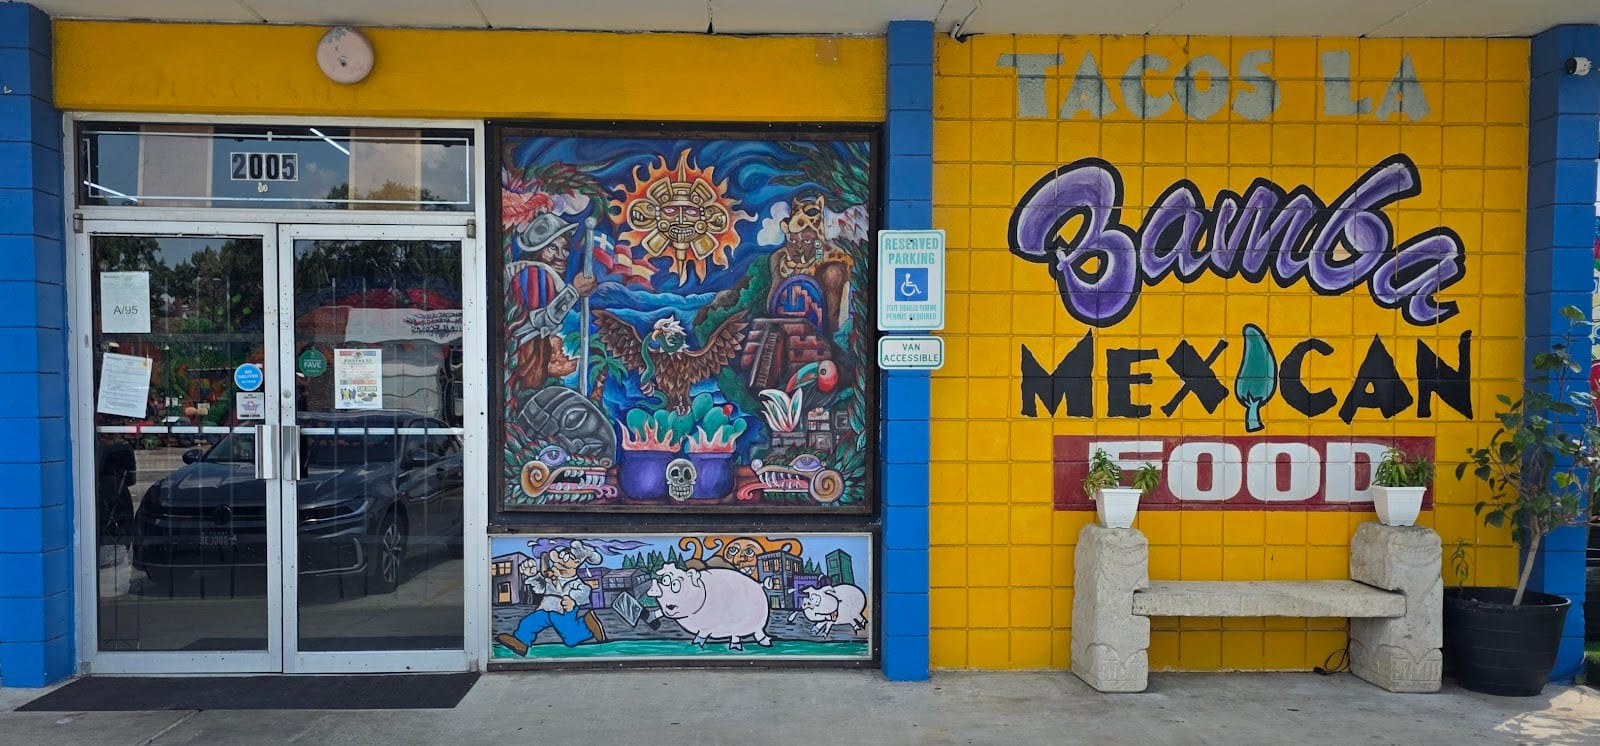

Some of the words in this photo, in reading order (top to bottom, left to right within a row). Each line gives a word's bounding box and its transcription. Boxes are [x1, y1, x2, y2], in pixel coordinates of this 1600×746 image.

[996, 49, 1281, 121] TACOS
[1321, 49, 1431, 121] LA
[231, 153, 296, 180] 2005
[884, 238, 939, 250] RESERVED
[1008, 153, 1466, 327] Bamba
[888, 252, 935, 265] PARKING
[113, 305, 138, 315] A/95
[902, 343, 920, 351] VAN
[884, 354, 939, 362] ACCESSIBLE
[303, 361, 322, 369] FAVE
[1088, 440, 1394, 502] FOOD
